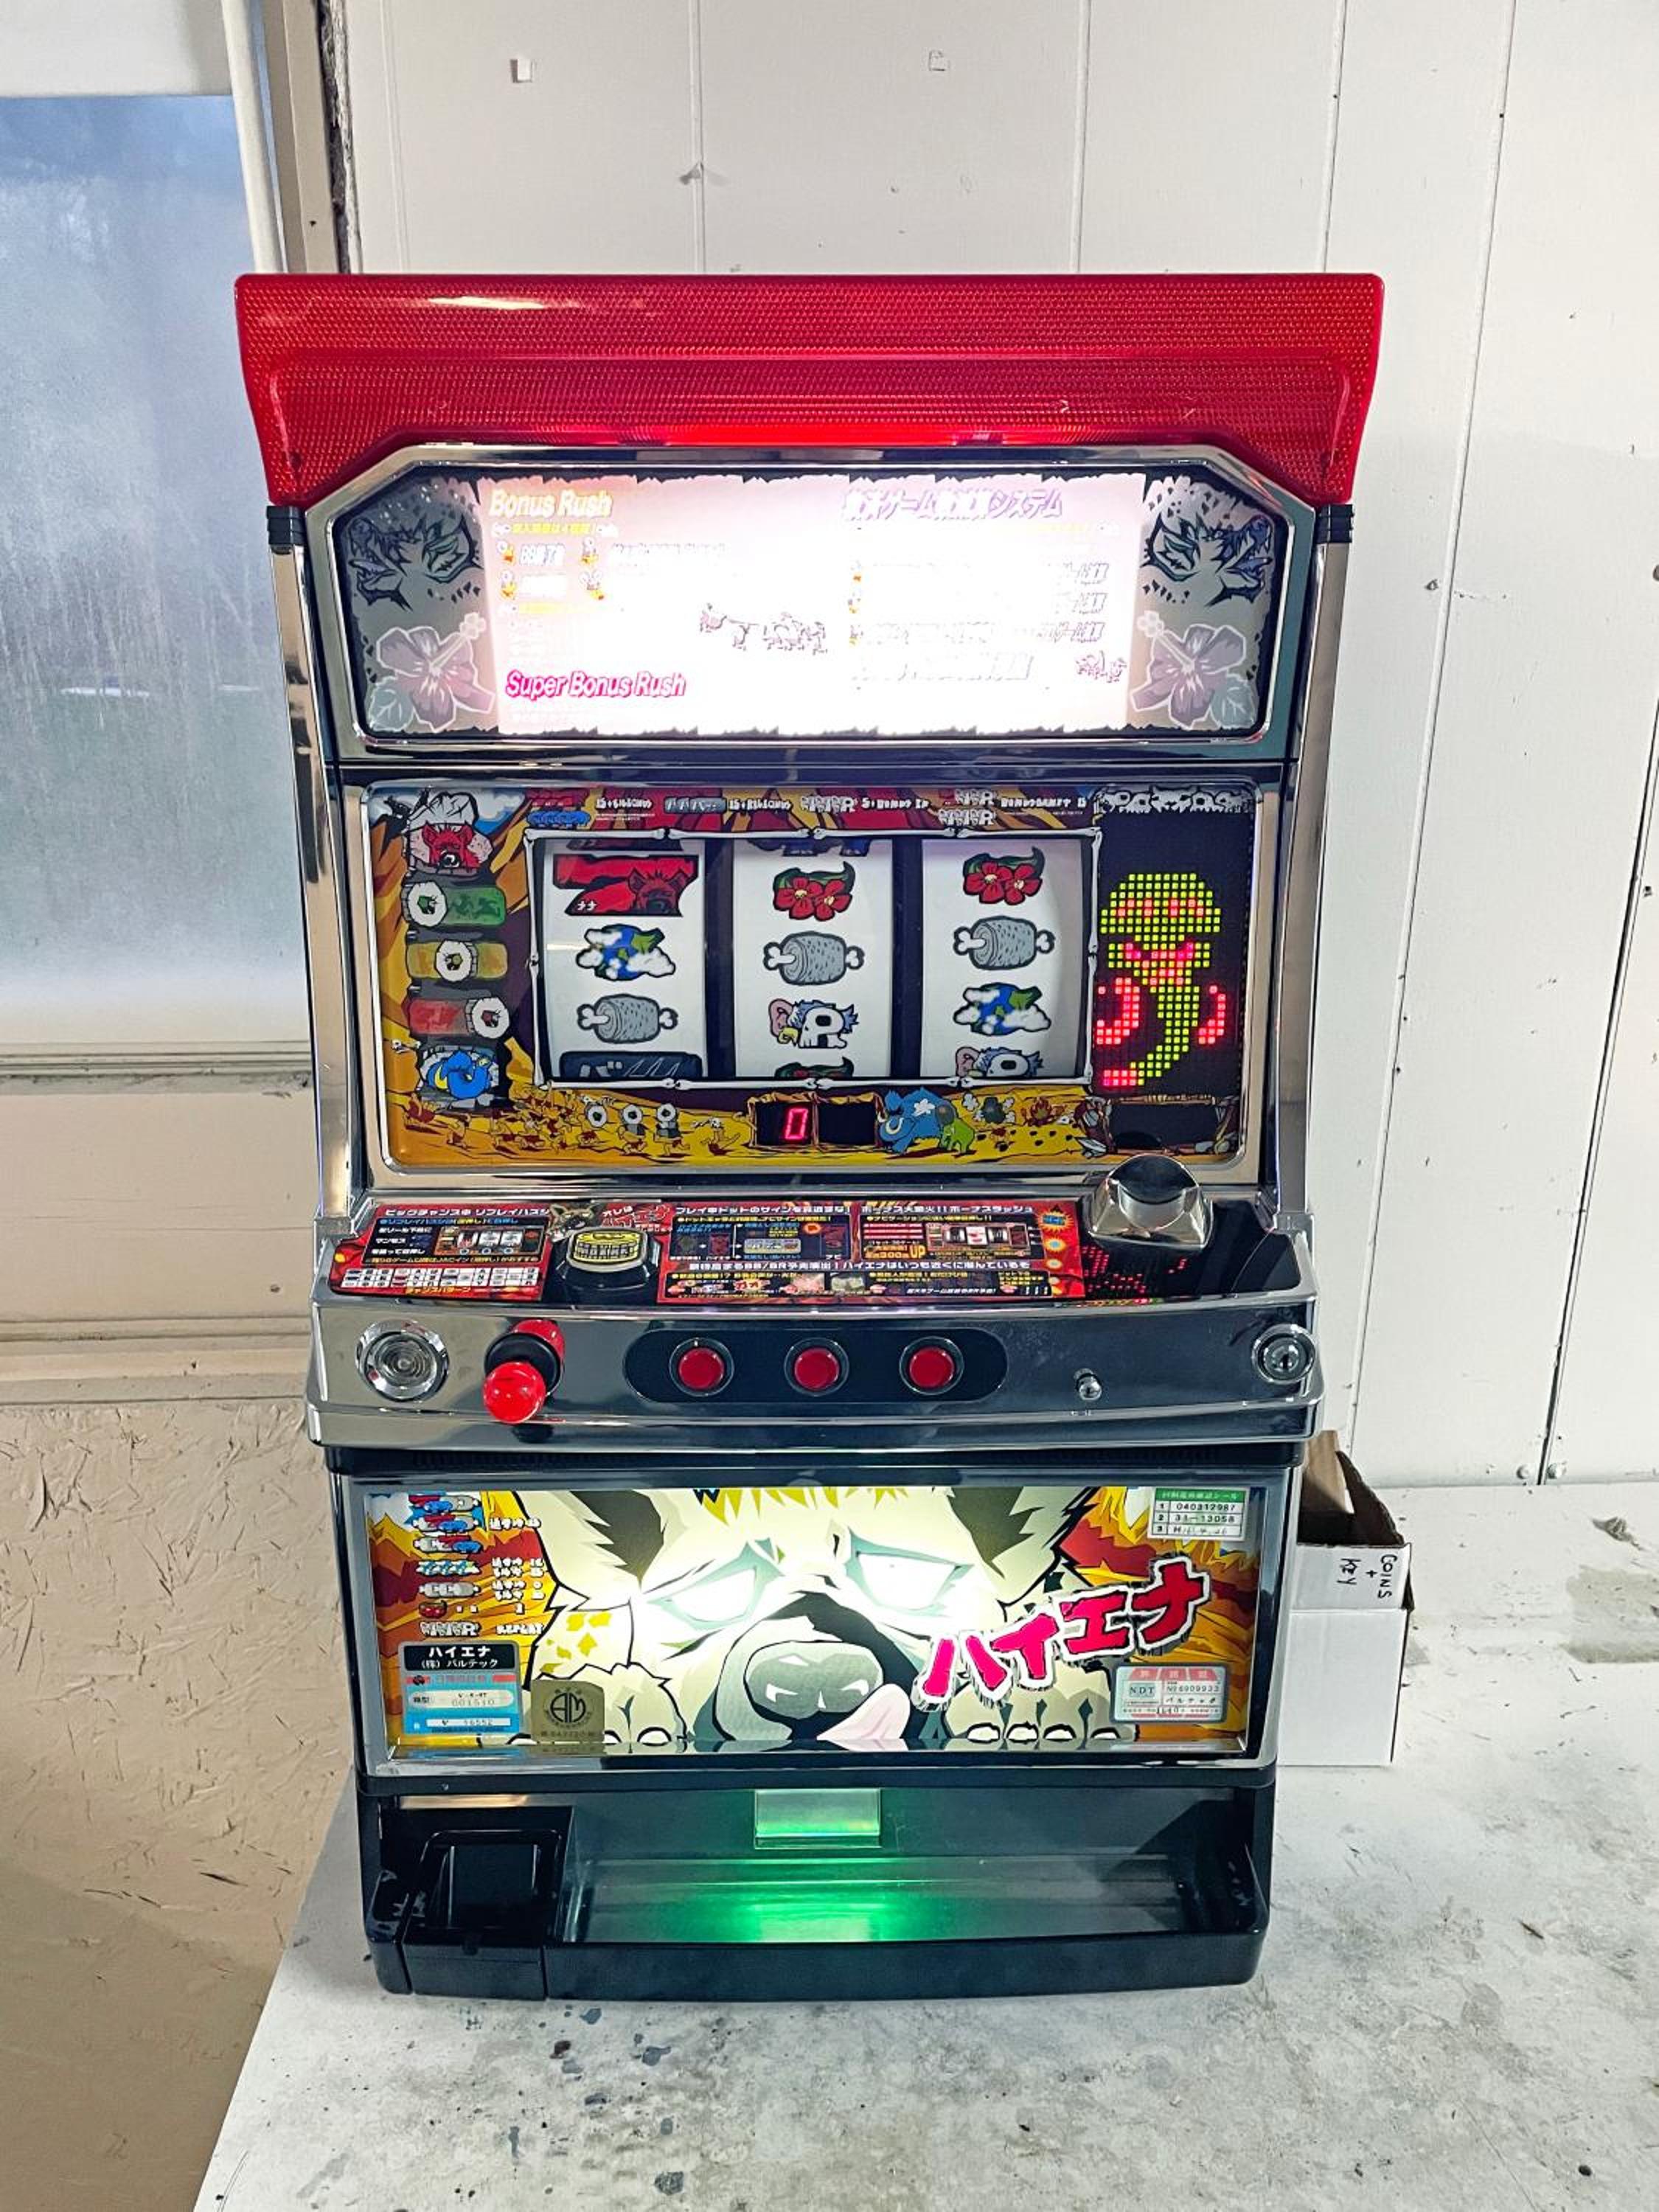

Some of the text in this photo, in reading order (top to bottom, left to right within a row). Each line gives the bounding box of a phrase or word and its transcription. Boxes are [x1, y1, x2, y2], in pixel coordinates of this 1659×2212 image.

[490, 489, 613, 518] Bonus Rush
[506, 669, 686, 700] Super Bonus Rush
[785, 1108, 808, 1139] 0
[910, 1245, 925, 1259] UP
[1378, 1554, 1398, 1599] COINS
[917, 1557, 1208, 1703] ハイエナ
[428, 1645, 491, 1658] ハイエナ
